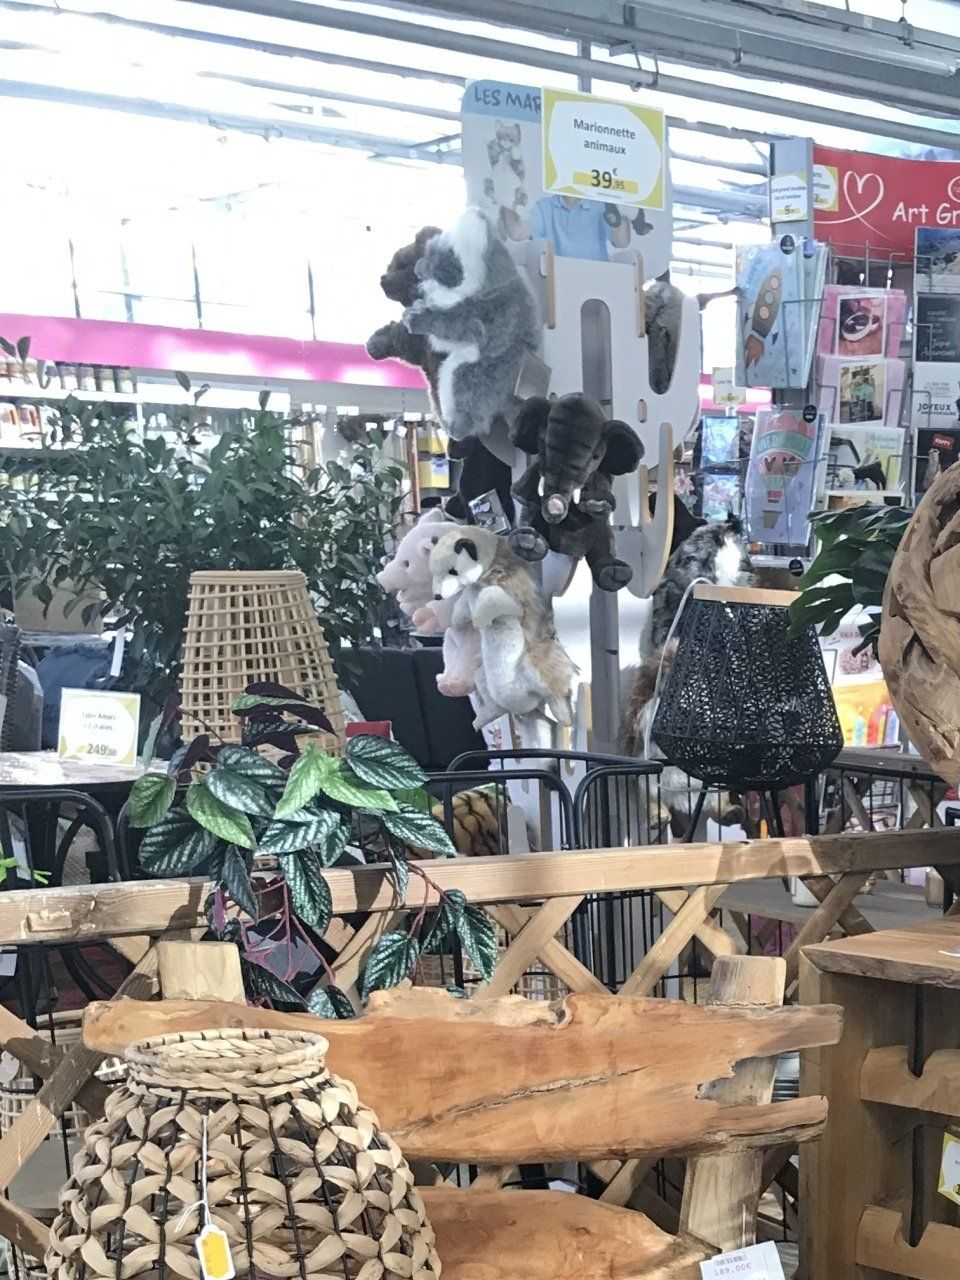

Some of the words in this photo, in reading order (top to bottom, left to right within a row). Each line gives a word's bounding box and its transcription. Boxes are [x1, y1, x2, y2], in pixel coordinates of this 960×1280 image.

[474, 86, 501, 107] LES
[573, 118, 636, 140] Marionnette
[584, 139, 626, 155] animaux
[892, 201, 929, 224] Art
[917, 403, 951, 412] JOYEUX
